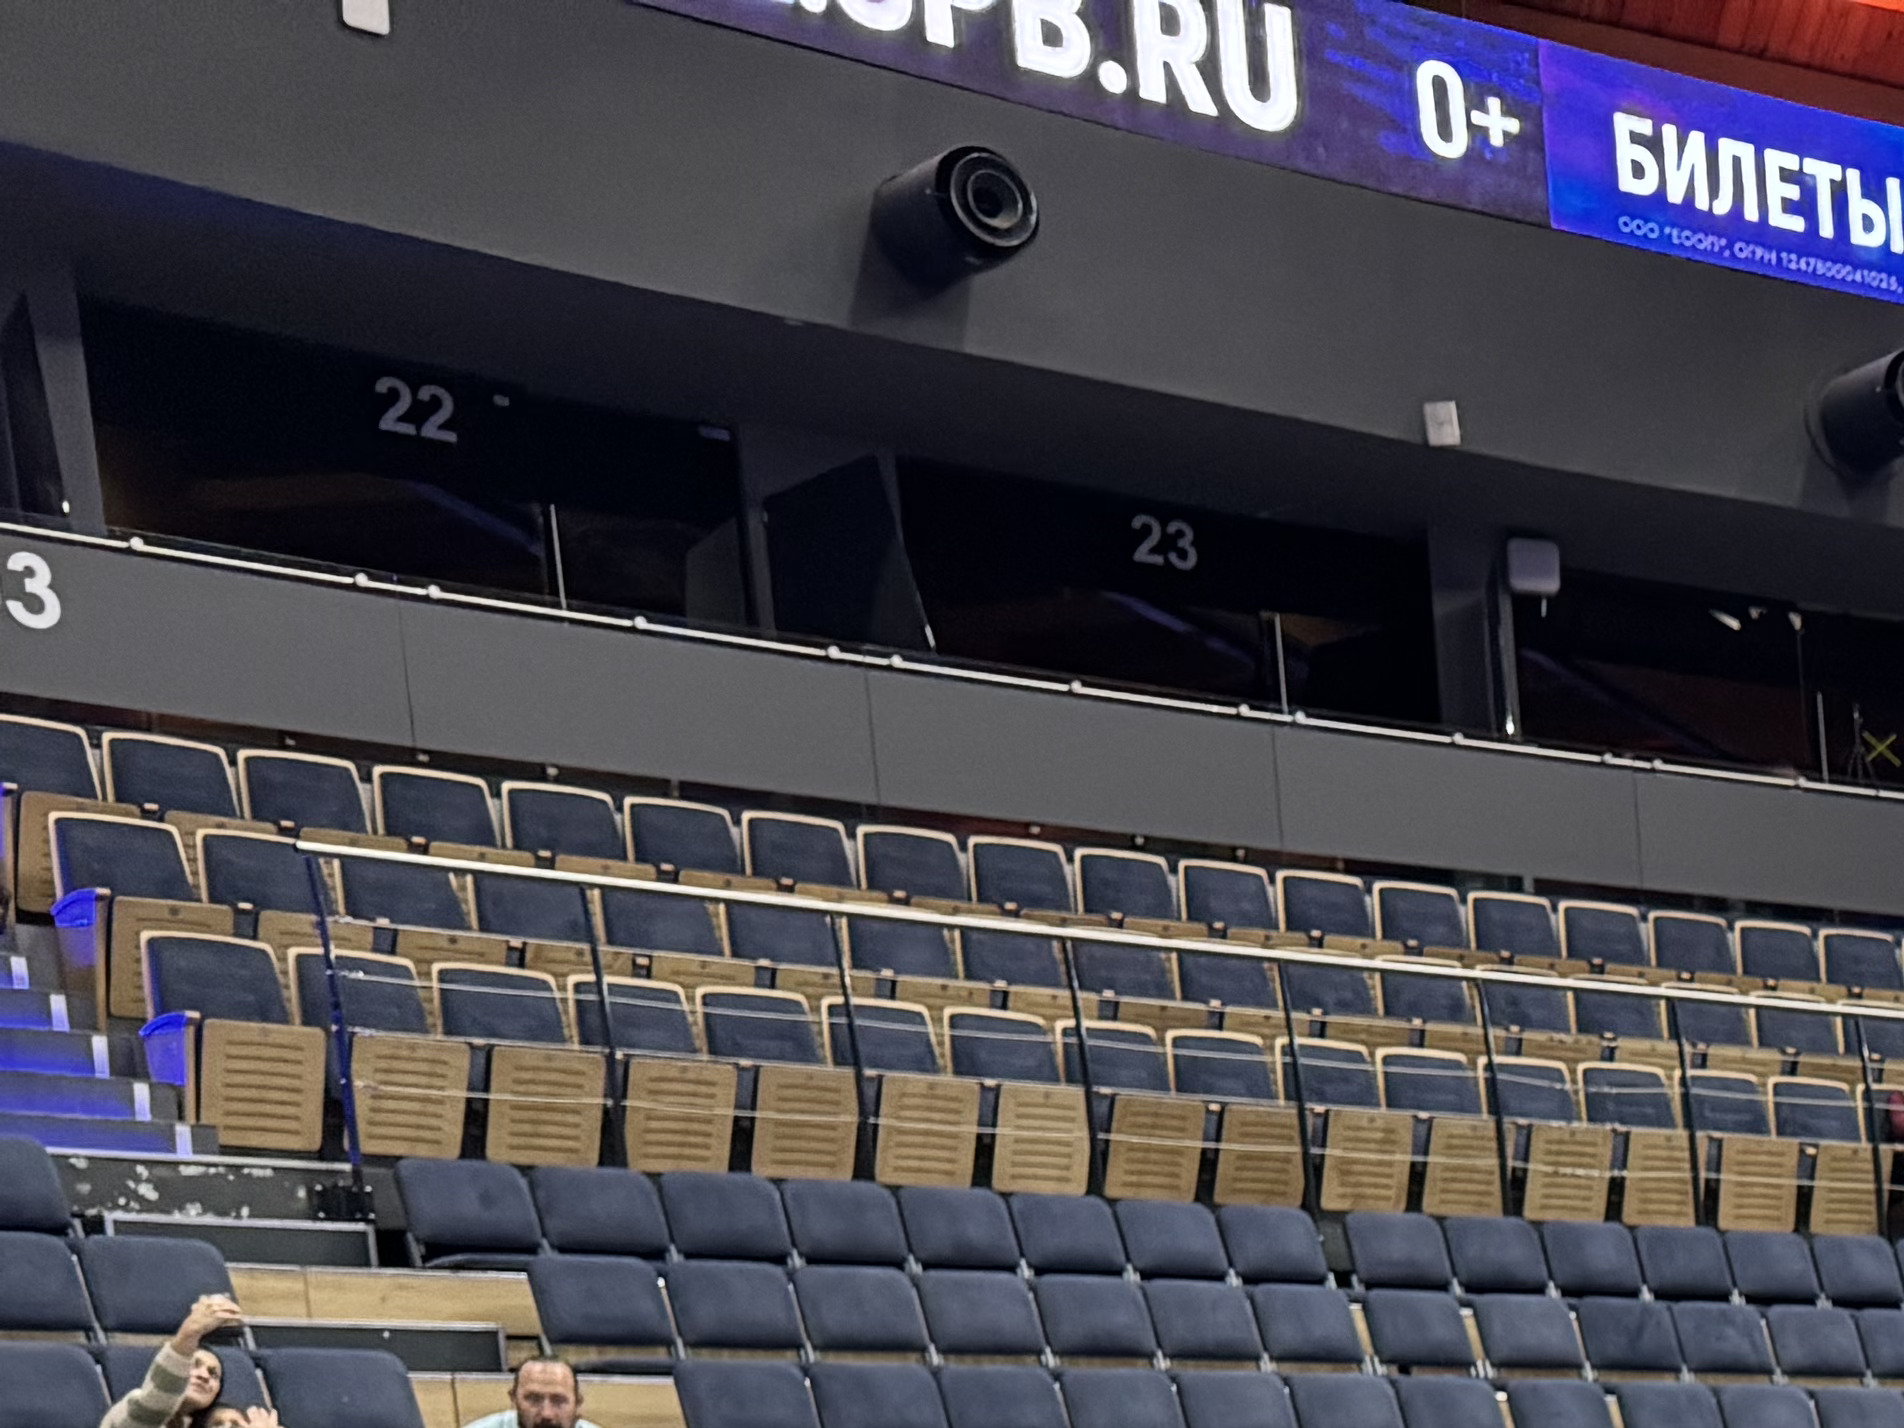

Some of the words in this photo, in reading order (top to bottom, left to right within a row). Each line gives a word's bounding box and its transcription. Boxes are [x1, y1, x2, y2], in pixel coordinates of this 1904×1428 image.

[1416, 60, 1520, 159] 0+
[1613, 111, 1904, 254] БИЛЕТЫ
[375, 376, 458, 443] 22
[1131, 514, 1199, 572] 23
